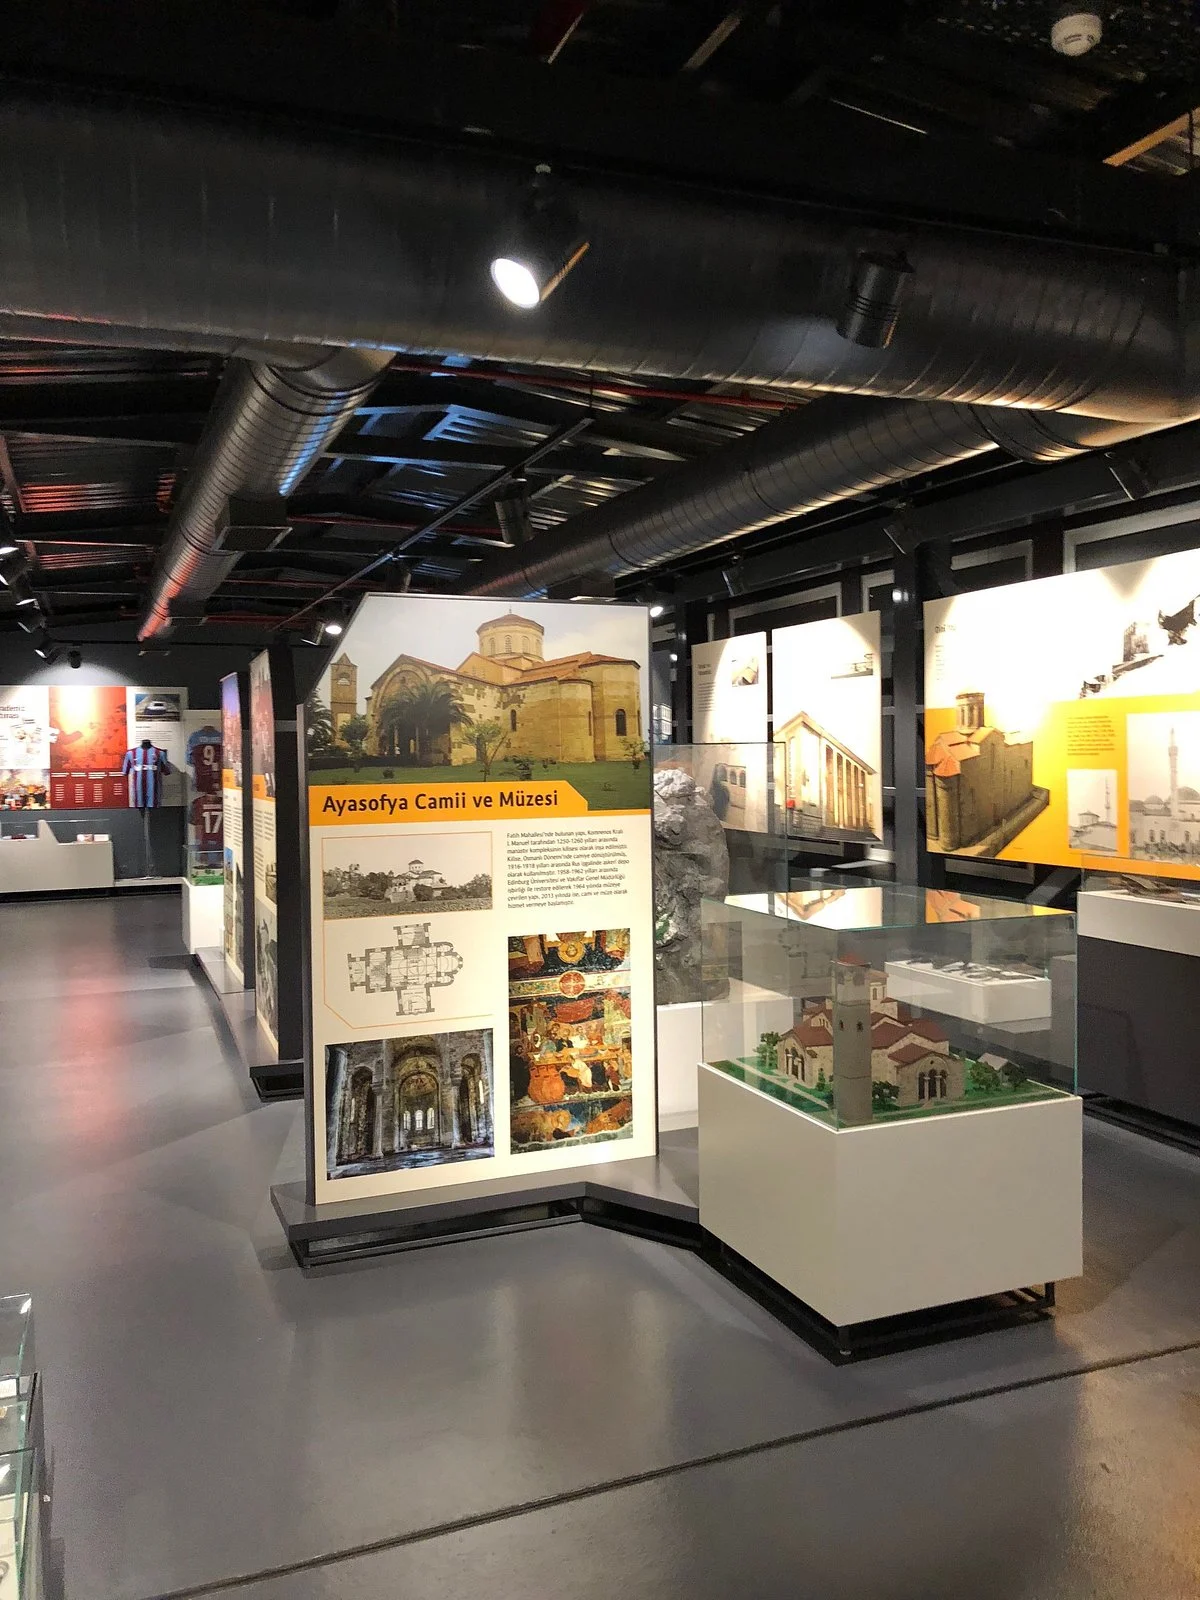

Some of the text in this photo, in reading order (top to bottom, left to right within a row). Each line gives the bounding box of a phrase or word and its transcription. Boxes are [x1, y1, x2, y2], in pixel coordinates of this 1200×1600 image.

[203, 745, 215, 766] 9
[322, 790, 558, 816] Ayasofya Camii ve Müzesi
[202, 811, 223, 834] 17
